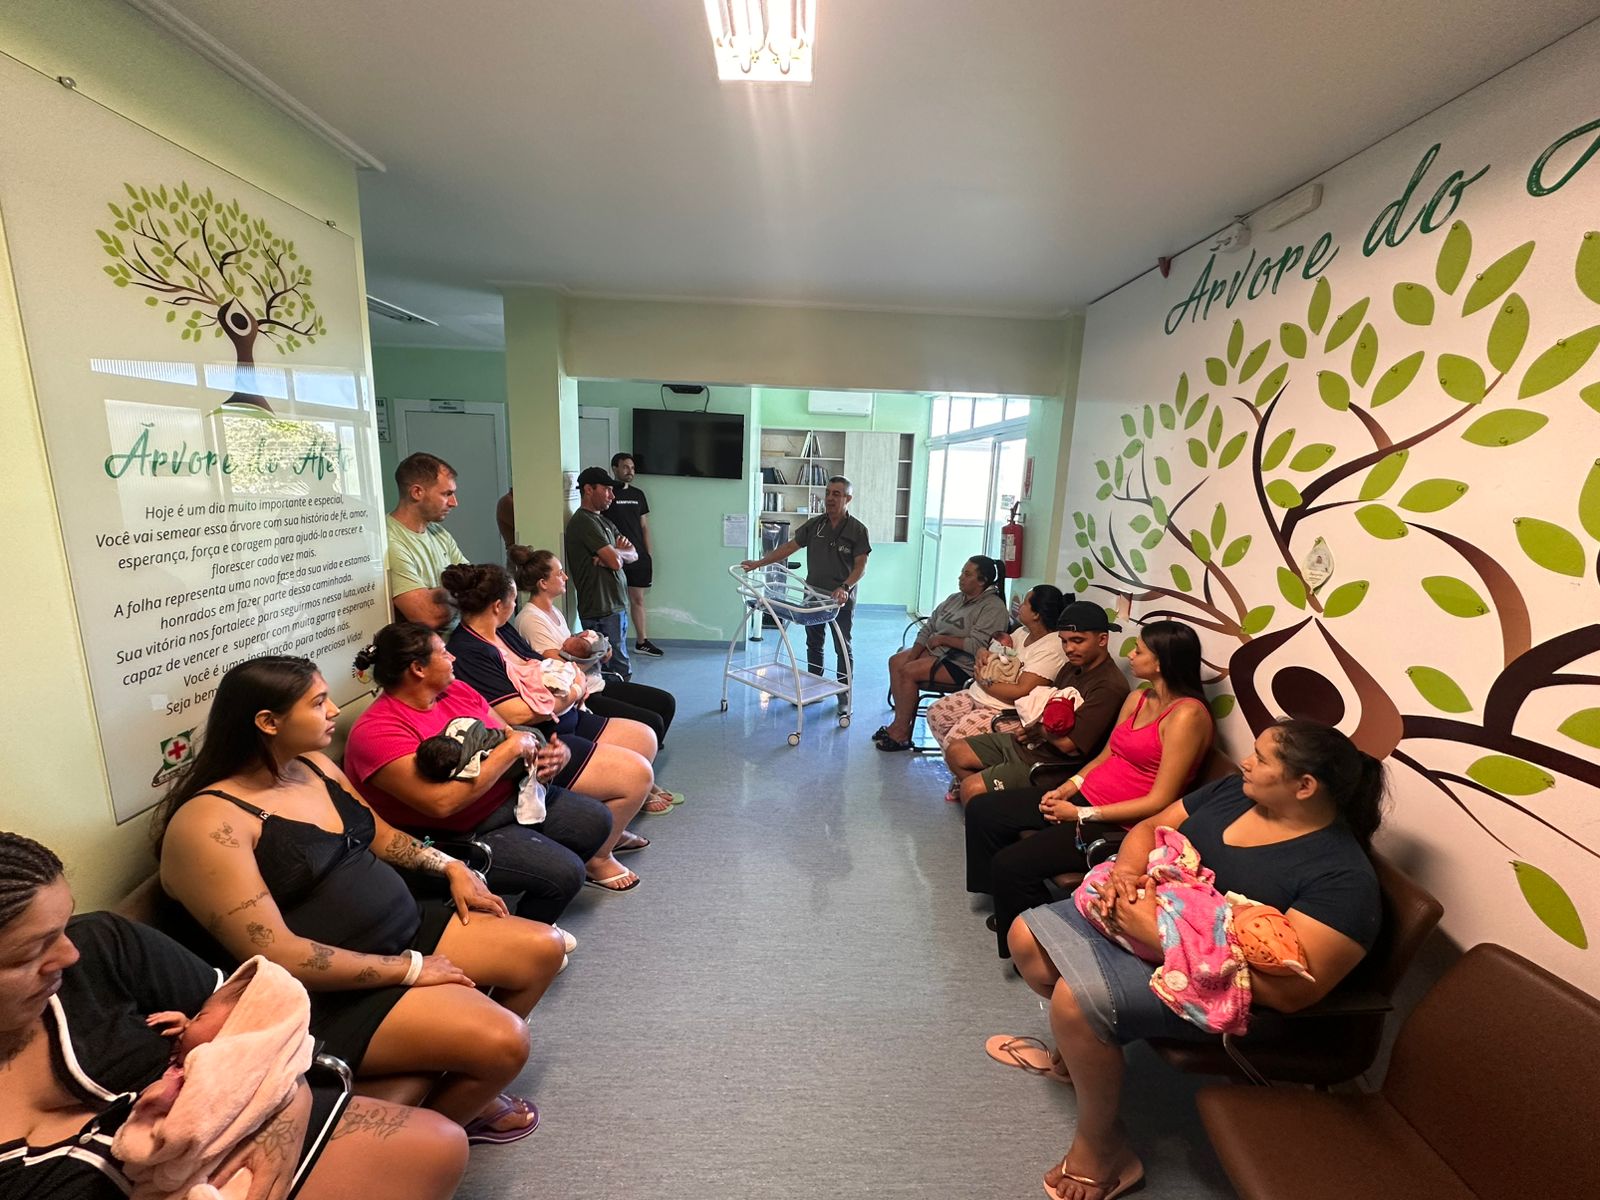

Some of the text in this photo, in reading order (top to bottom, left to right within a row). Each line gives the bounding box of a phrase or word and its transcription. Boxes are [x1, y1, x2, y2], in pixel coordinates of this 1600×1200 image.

[1362, 142, 1491, 257] do
[95, 531, 130, 548] Você
[133, 529, 153, 543] vai
[156, 527, 201, 541] semear
[204, 524, 227, 536] essa
[230, 520, 261, 533] árvore
[263, 519, 282, 529] com
[284, 517, 299, 527] sua
[300, 511, 329, 524] história
[330, 510, 339, 521] de
[145, 506, 174, 521] Hoje
[177, 504, 184, 517] é
[187, 505, 206, 516] um
[208, 502, 225, 514] dia
[228, 501, 257, 513] muito
[259, 498, 307, 512] importante
[308, 498, 313, 507] e
[118, 550, 188, 571] esperança,
[191, 545, 220, 562] força
[222, 544, 229, 553] e
[231, 538, 272, 552] coragem
[274, 534, 294, 546] para
[295, 529, 327, 544] ajudá-la
[328, 530, 334, 538] a
[334, 526, 358, 537] crescer
[211, 548, 317, 579] florescer cada vez mais.
[113, 604, 124, 618] A
[126, 598, 162, 619] folha
[165, 585, 226, 607] representa
[228, 580, 251, 593] uma
[253, 574, 275, 587] nova
[277, 570, 295, 585] fase
[296, 567, 307, 577] da
[308, 565, 322, 575] sua
[323, 560, 338, 571] vida
[344, 554, 371, 567] estamos
[160, 607, 216, 630] honrados
[219, 603, 235, 615] em
[237, 596, 261, 613] fazer
[263, 590, 287, 606] parte
[288, 586, 311, 597] dessa
[116, 649, 142, 665] Sua
[145, 636, 186, 656] vitória
[189, 630, 209, 644] nos
[210, 616, 256, 641] fortalece
[257, 610, 279, 626] para
[280, 599, 321, 617] seguirmos
[322, 593, 342, 605] nessa
[122, 664, 162, 686] capaz
[165, 658, 181, 672] de
[183, 646, 220, 666] vencer
[222, 644, 228, 654] e
[233, 630, 270, 650] superar
[272, 625, 290, 637] com
[292, 617, 315, 631] muita
[316, 611, 336, 626] garra
[316, 639, 345, 659] preciosa
[346, 630, 363, 643] Vida!
[183, 667, 210, 687] Você
[213, 664, 219, 677] é
[296, 634, 314, 650] para
[315, 627, 335, 639] todos
[336, 621, 351, 633] nós.
[166, 698, 191, 716] Seja
